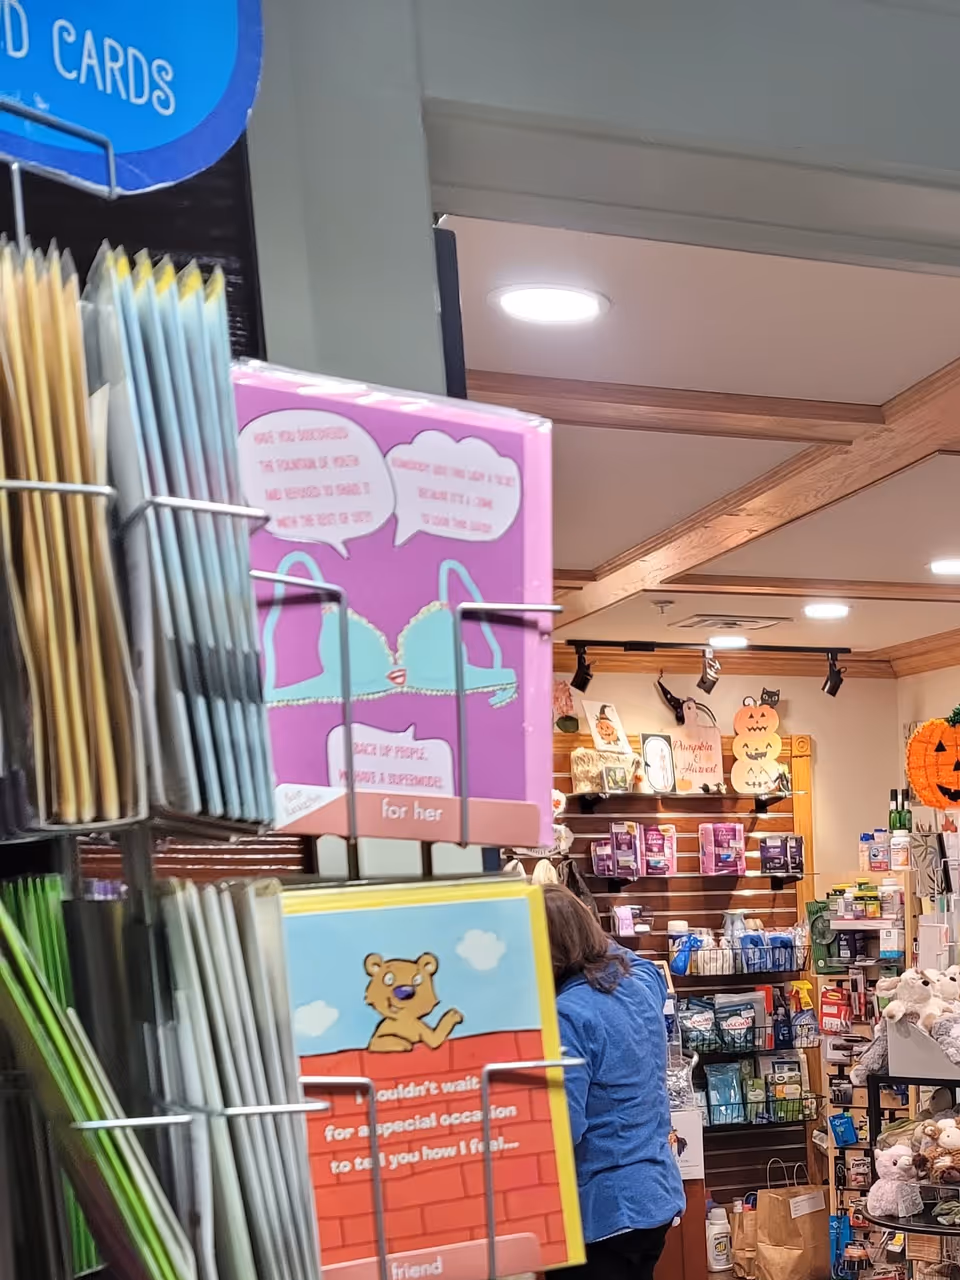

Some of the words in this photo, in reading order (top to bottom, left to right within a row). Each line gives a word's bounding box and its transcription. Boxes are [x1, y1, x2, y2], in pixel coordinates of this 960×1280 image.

[0, 0, 29, 58] D
[52, 18, 176, 117] CARDS
[380, 772, 385, 784] A
[382, 798, 408, 820] for
[414, 801, 443, 821] her
[374, 1080, 439, 1103] ouldn't
[441, 1075, 480, 1093] wait
[324, 1124, 354, 1142] for
[440, 1104, 517, 1127] occaion
[330, 1161, 351, 1175] to
[354, 1154, 386, 1172] tel
[389, 1150, 420, 1171] you
[422, 1145, 458, 1162] how
[459, 1140, 467, 1155] I
